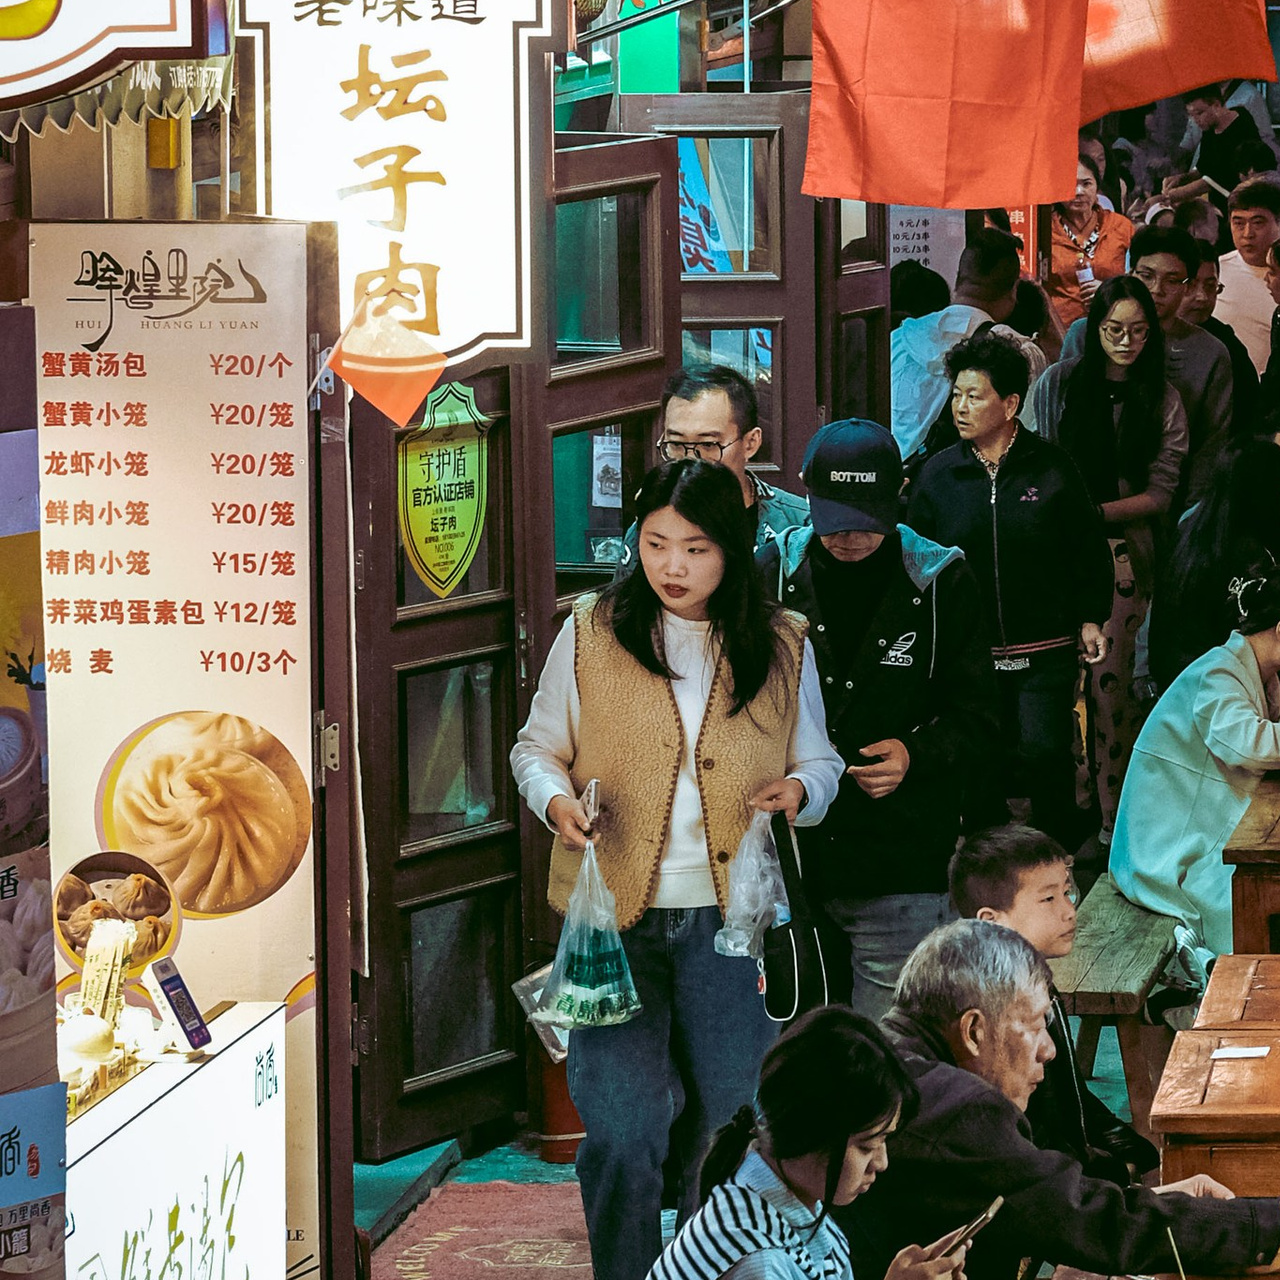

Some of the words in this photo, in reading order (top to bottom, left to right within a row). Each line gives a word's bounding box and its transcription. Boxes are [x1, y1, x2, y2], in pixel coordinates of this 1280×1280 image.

[337, 42, 449, 336] 坛子肉
[75, 320, 102, 329] HUI
[140, 320, 193, 329] HUANG
[199, 320, 213, 329] LI
[219, 320, 260, 329] YUAN
[42, 352, 147, 378] 蟹黄汤包
[209, 353, 293, 378] ¥20/个
[42, 401, 148, 428] 蟹黄小笼
[210, 403, 294, 428] ¥20/笼
[44, 451, 149, 477] 龙虾小笼
[211, 451, 295, 477] ¥20/笼
[419, 446, 467, 483] 守护盾
[412, 479, 475, 508] 官方认证店铺
[44, 500, 150, 526] 鲜肉小笼
[211, 501, 296, 526] ¥20/笼
[430, 515, 457, 532] 坛子肉
[46, 549, 151, 575] 精肉小笼
[212, 550, 297, 576] ¥15/笼
[46, 599, 204, 625] 荠菜鸡蛋素包
[214, 600, 297, 626] ¥12/笼
[200, 649, 297, 675] ¥10/3个
